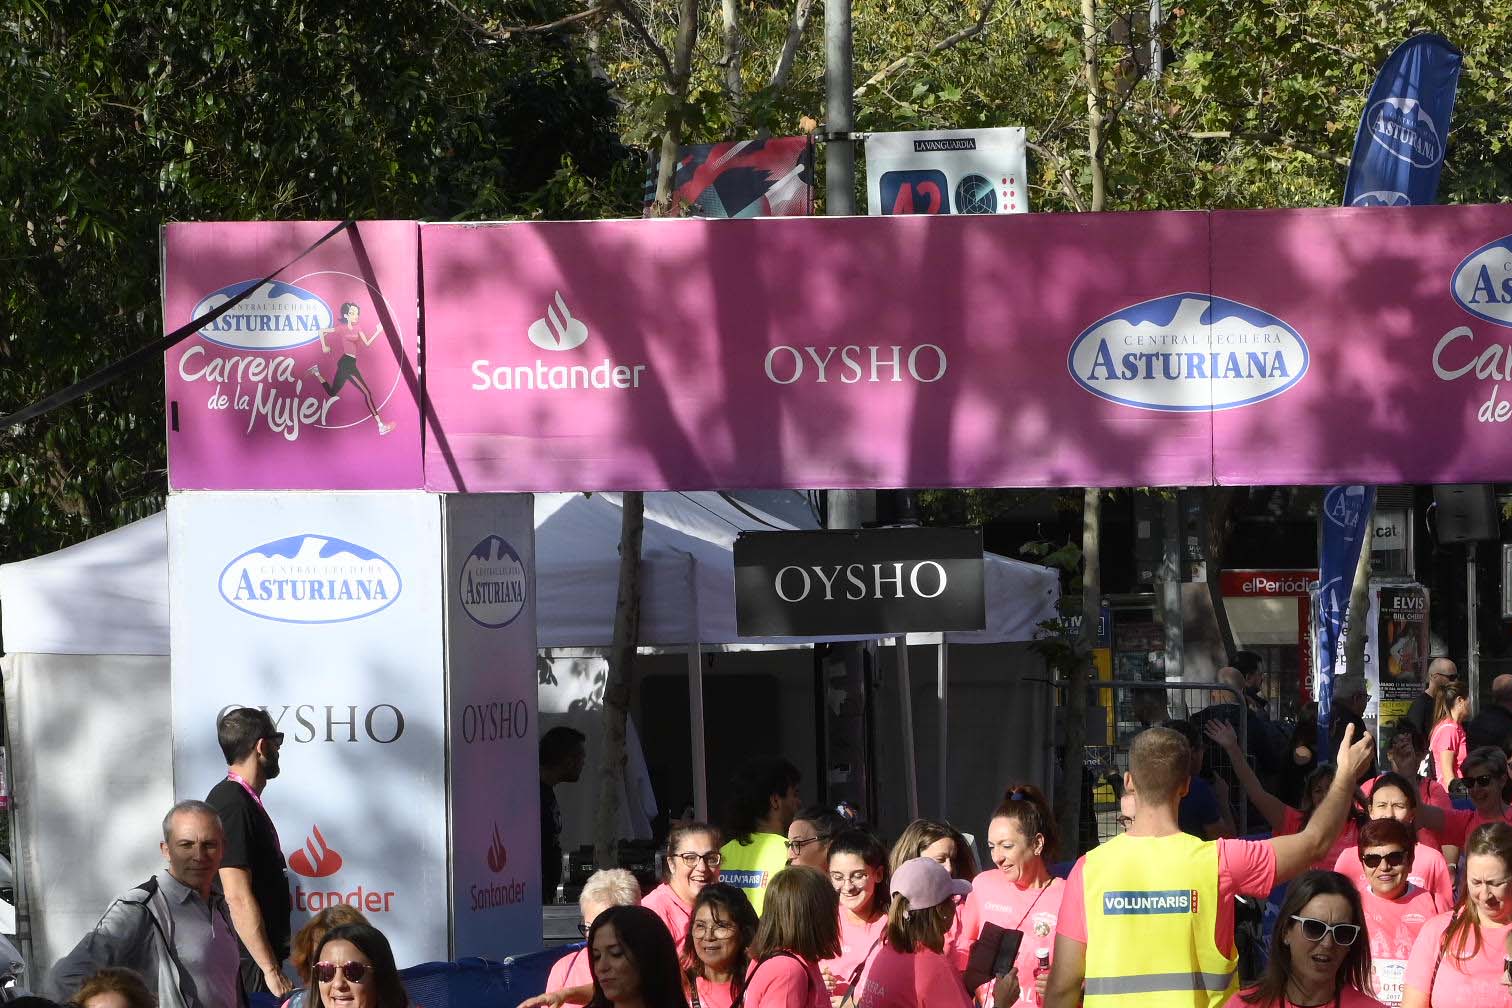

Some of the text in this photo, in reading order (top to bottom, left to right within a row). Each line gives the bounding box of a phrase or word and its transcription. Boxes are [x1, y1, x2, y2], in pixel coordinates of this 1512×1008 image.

[1123, 333, 1282, 346] CENTRAL LECHERA
[179, 345, 296, 382] Carrera
[471, 359, 646, 391] Santander
[764, 343, 948, 385] OYSHO
[1086, 337, 1291, 381] ASTURIANA
[207, 380, 341, 441] de la Mujer
[1477, 384, 1512, 424] de
[232, 567, 389, 602] ASTURIANA
[464, 568, 523, 606] ASTURIANA
[774, 561, 947, 603] OYSHO
[1393, 596, 1424, 609] ELVIS
[216, 703, 406, 745] YSHO
[462, 700, 529, 745] OYSHO
[470, 879, 526, 912] Santander
[718, 872, 761, 885] OLUNTARIS
[1104, 895, 1189, 911] VOLUNTARIS
[1383, 983, 1405, 992] 016
